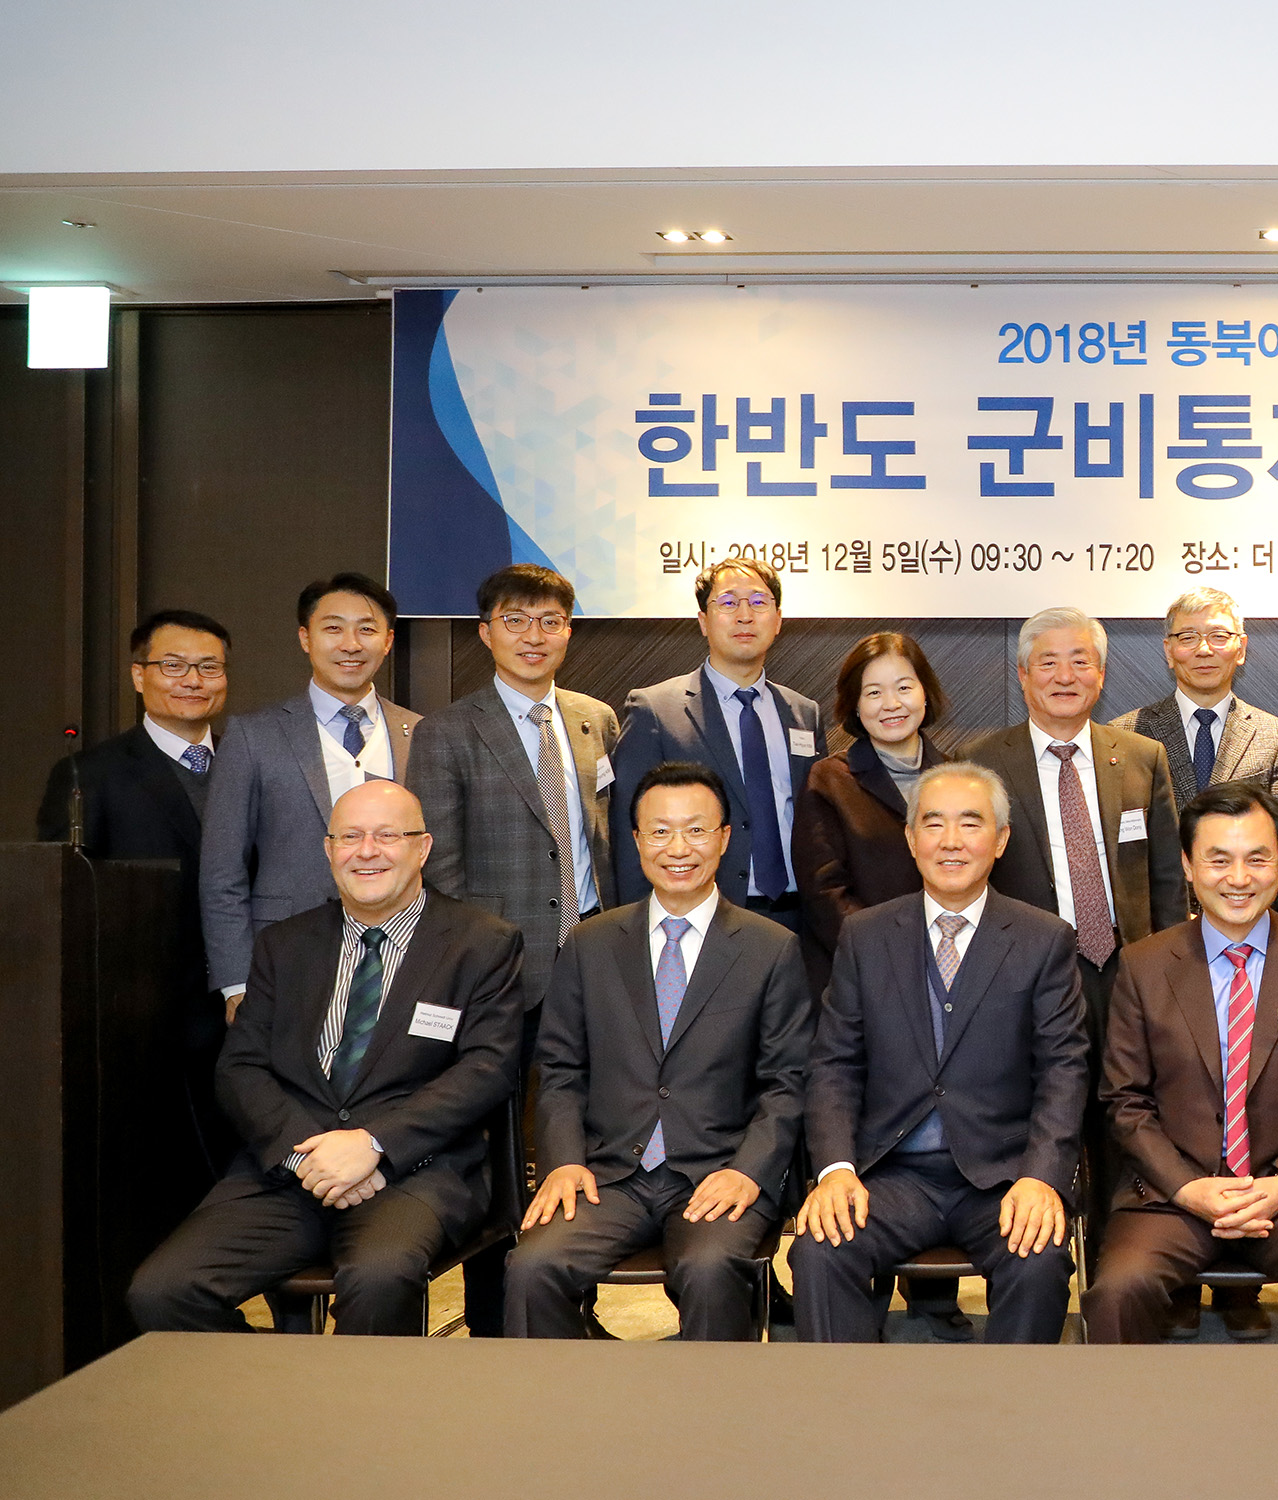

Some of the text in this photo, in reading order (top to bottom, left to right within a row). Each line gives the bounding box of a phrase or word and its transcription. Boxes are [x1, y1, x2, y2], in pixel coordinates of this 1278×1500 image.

[998, 320, 1147, 366] 2018년
[635, 393, 926, 497] 한반도
[659, 540, 715, 574] 일시:
[821, 539, 872, 574] 12월
[882, 538, 962, 576] 5일(수)
[970, 543, 1042, 572] 09:30
[1085, 543, 1155, 572] 17:20
[1181, 540, 1238, 574] 장소:
[1252, 540, 1273, 574] 더
